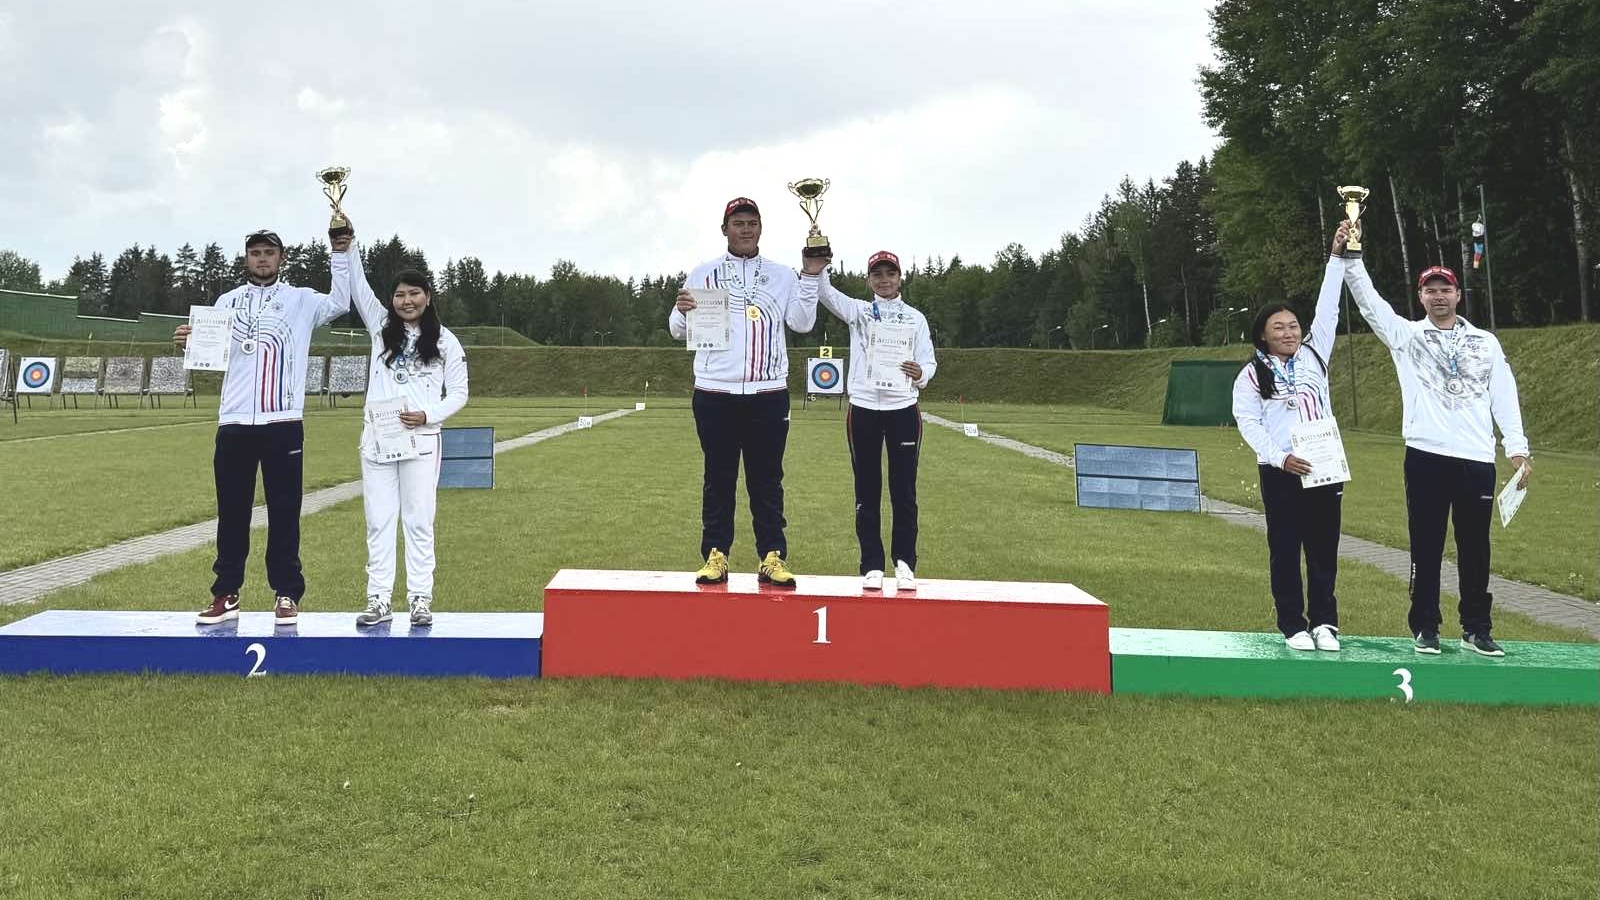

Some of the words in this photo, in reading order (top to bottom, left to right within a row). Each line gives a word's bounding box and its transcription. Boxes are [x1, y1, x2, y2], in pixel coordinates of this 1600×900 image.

[822, 348, 830, 357] 2
[812, 605, 832, 644] 1
[245, 642, 267, 679] 2
[1391, 667, 1413, 704] 3
